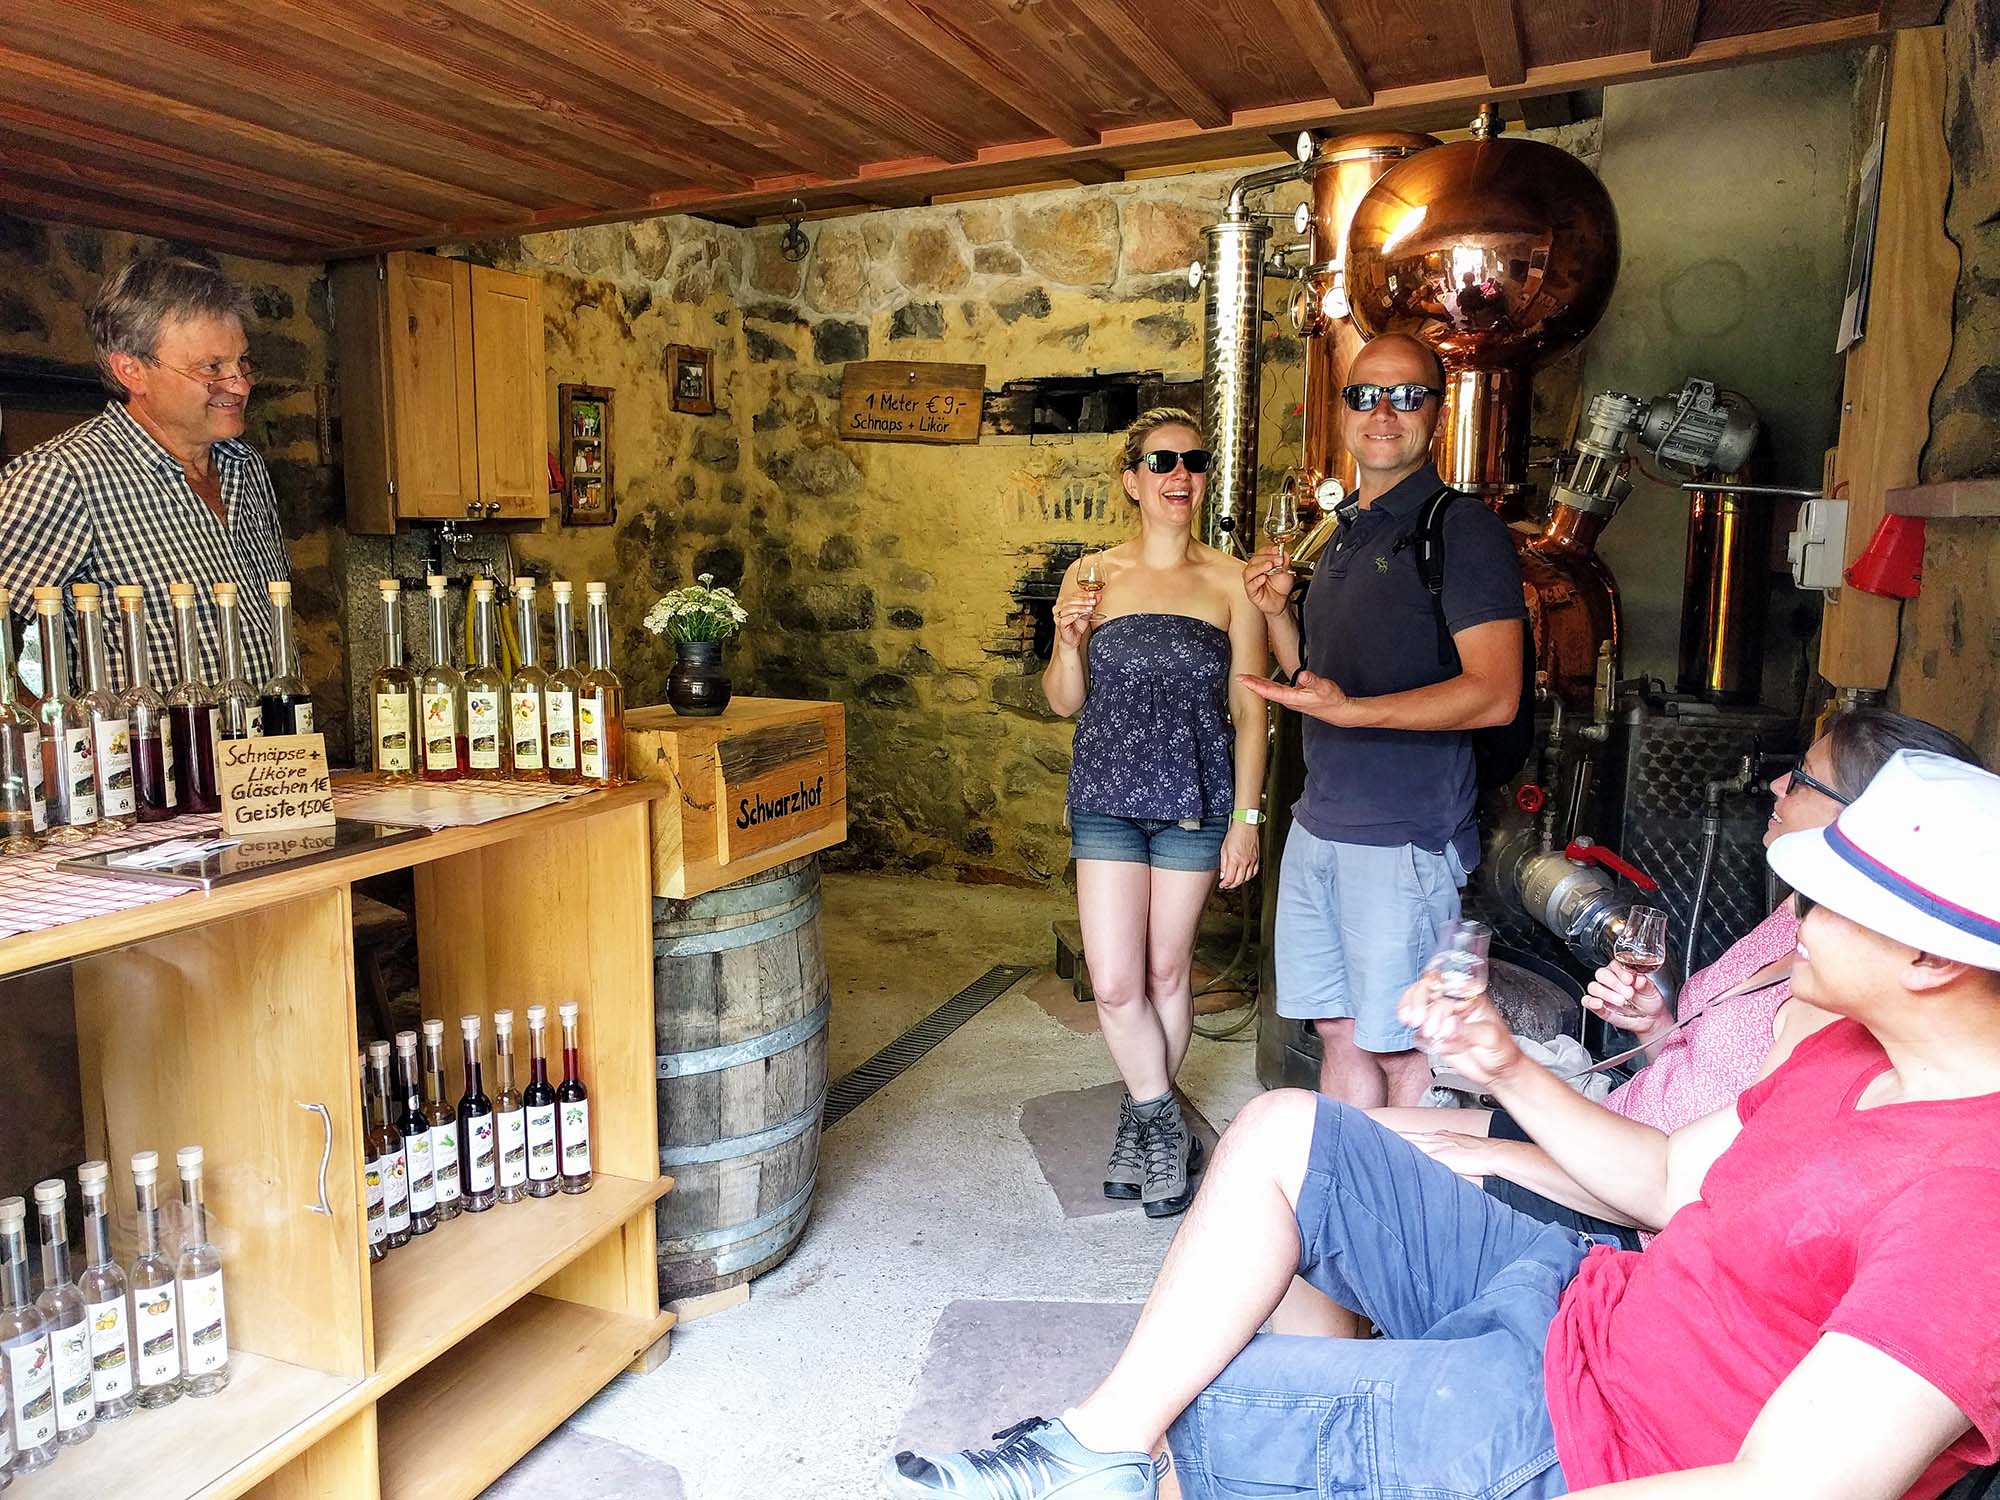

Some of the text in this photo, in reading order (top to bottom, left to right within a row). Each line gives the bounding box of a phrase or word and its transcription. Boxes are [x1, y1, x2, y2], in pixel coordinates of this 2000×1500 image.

[865, 393, 875, 409] 1
[880, 393, 920, 413] Meter
[850, 413, 950, 433] Schnaps + Likör
[225, 743, 321, 767] Schnäpse +
[247, 766, 308, 782] Liköre
[231, 780, 308, 800] Gläschen
[235, 799, 296, 824] Geiste
[736, 775, 824, 829] Schwarzhof
